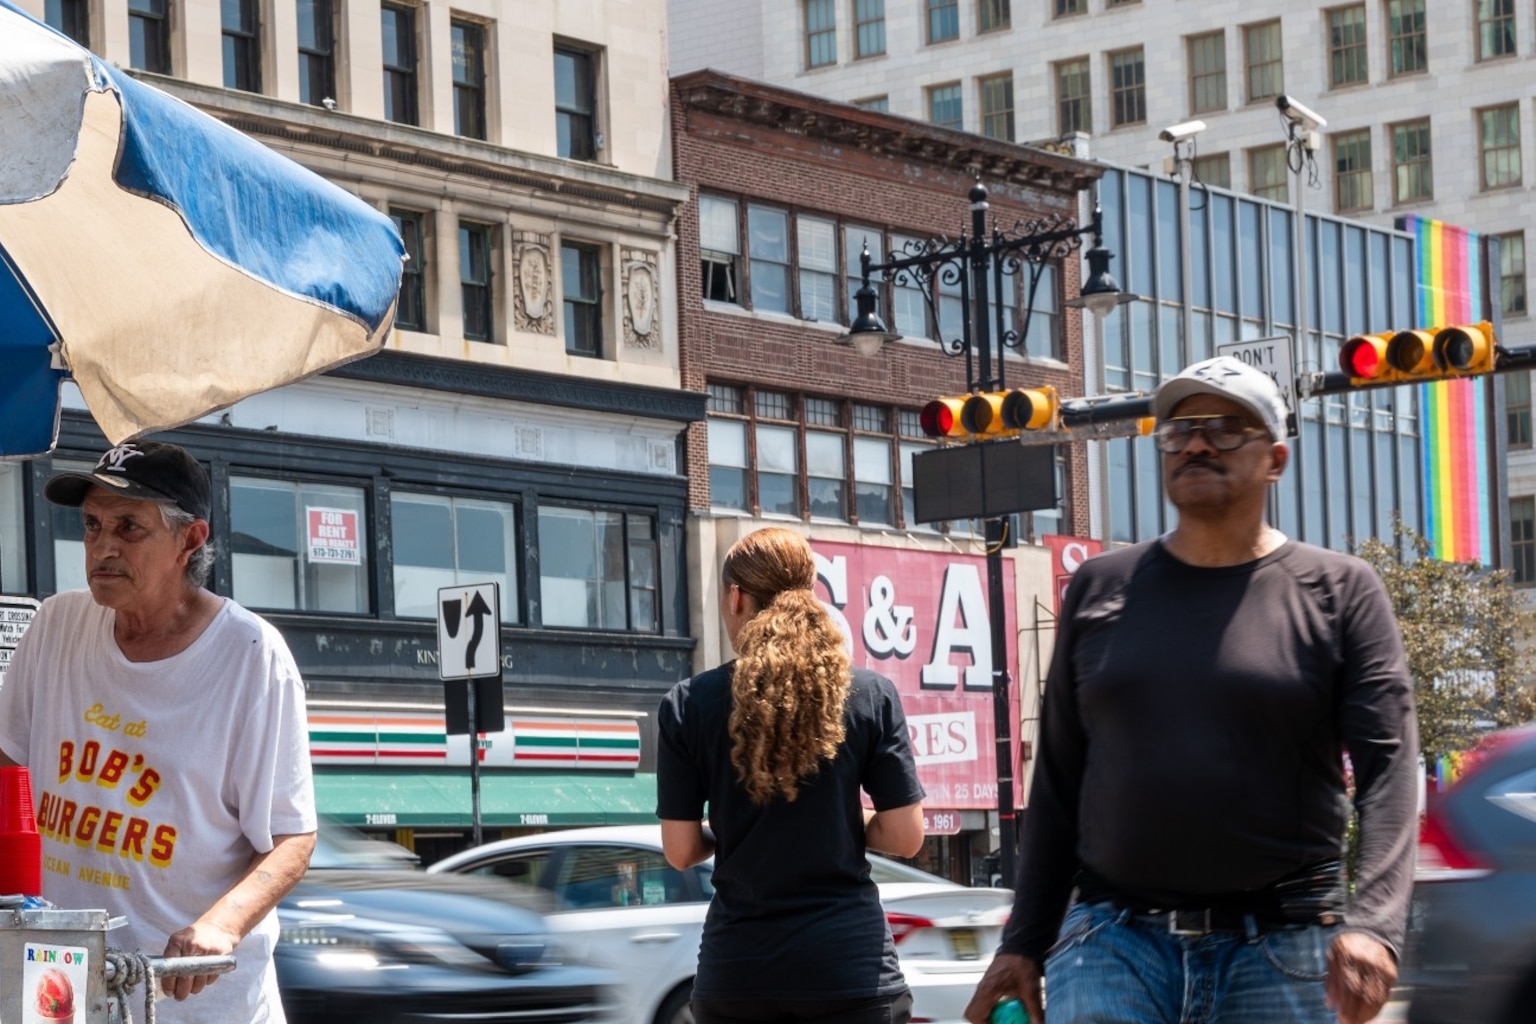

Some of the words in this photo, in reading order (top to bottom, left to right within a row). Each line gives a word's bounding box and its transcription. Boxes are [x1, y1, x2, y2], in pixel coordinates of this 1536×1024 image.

[321, 512, 343, 525] FOR
[318, 525, 347, 538] RENT
[863, 575, 917, 660] &
[920, 563, 994, 691] A
[2, 635, 21, 643] Vehicle
[416, 649, 439, 664] KIN
[84, 703, 121, 731] Eat
[123, 719, 148, 738] at
[908, 720, 968, 757] RES
[58, 740, 161, 808] BOB'S
[954, 783, 969, 799] 25
[365, 814, 397, 825] 7-ELEVEN
[520, 814, 548, 825] 7-ELEVEN
[933, 814, 954, 830] 1961
[36, 790, 179, 869] BURGERS
[78, 866, 131, 891] AVENUE
[27, 948, 84, 966] RAINOW
